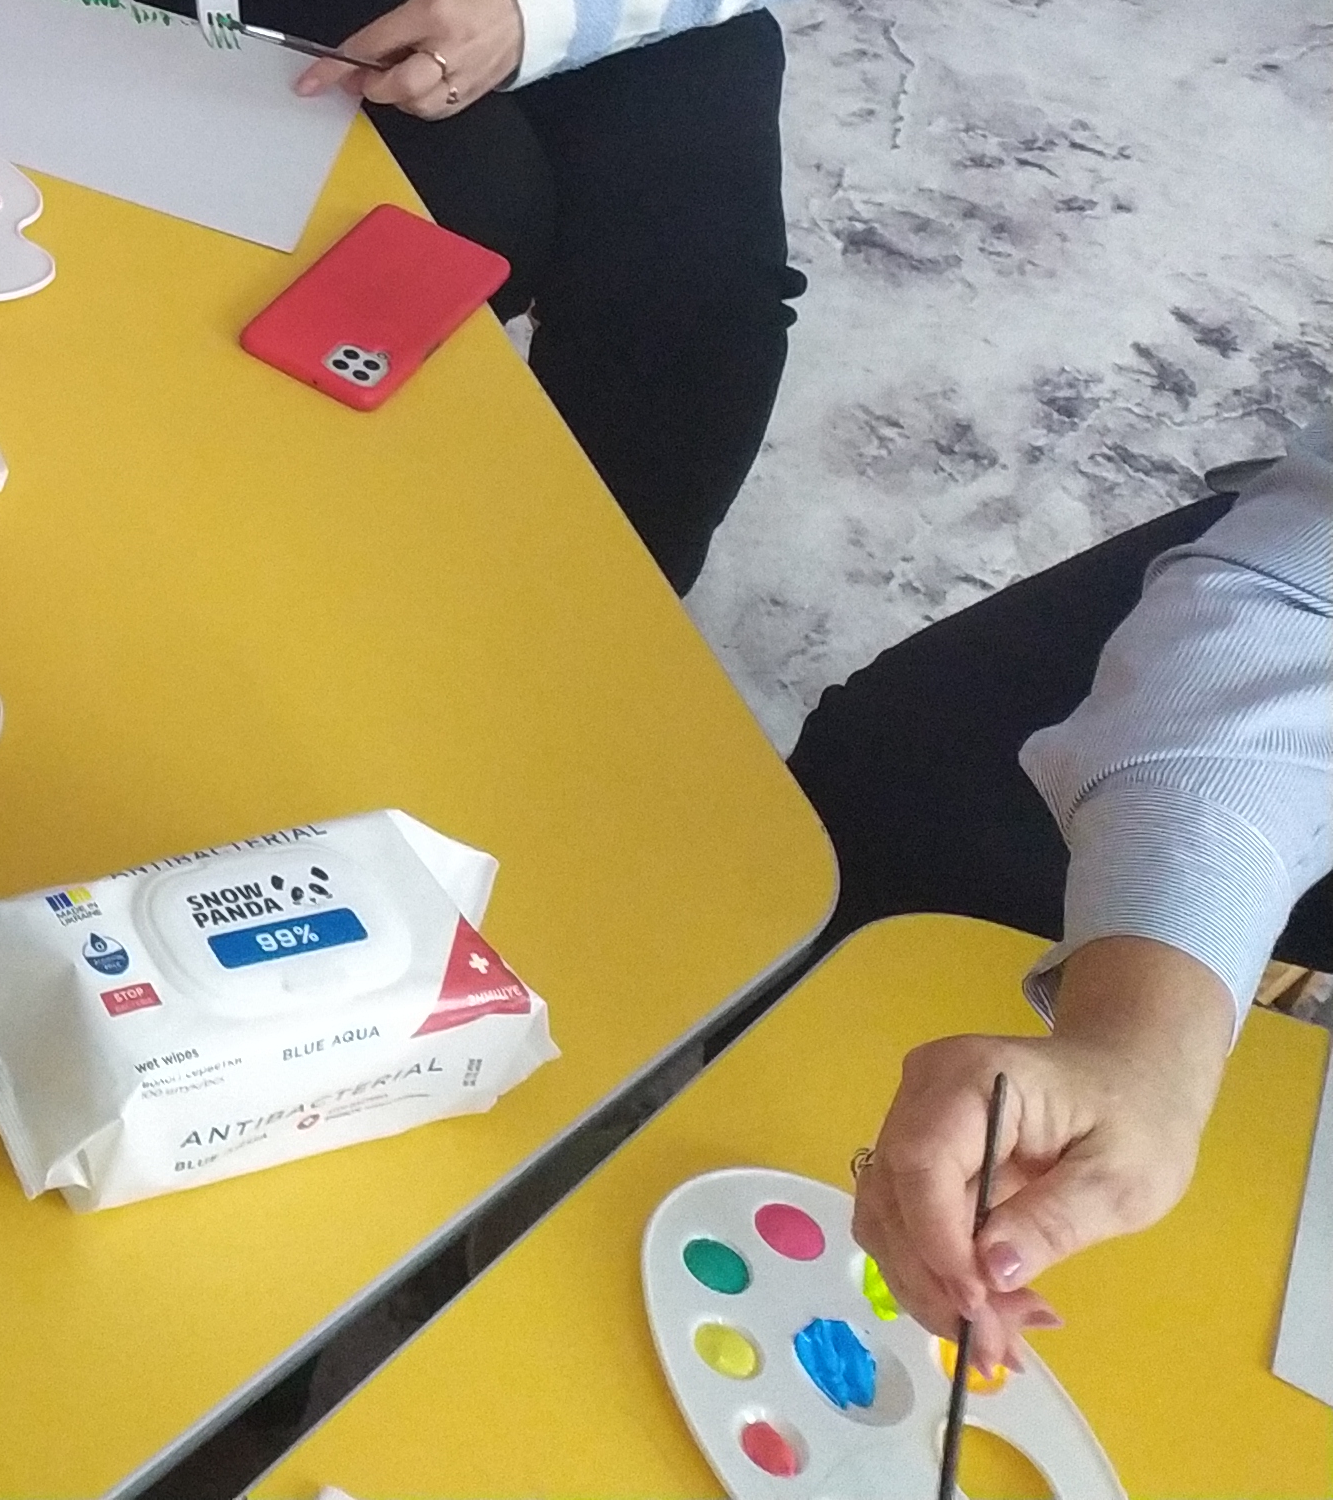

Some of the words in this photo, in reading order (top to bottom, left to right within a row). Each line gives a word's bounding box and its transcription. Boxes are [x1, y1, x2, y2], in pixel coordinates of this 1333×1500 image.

[186, 881, 264, 912] SNOW
[191, 896, 285, 929] PANDA
[255, 922, 320, 952] 99%
[282, 1038, 326, 1062] BLUE
[331, 1025, 381, 1047] AQUA
[133, 1057, 160, 1074] wet
[161, 1048, 200, 1065] wipes
[179, 1056, 443, 1149] ANTIBACTERIAL
